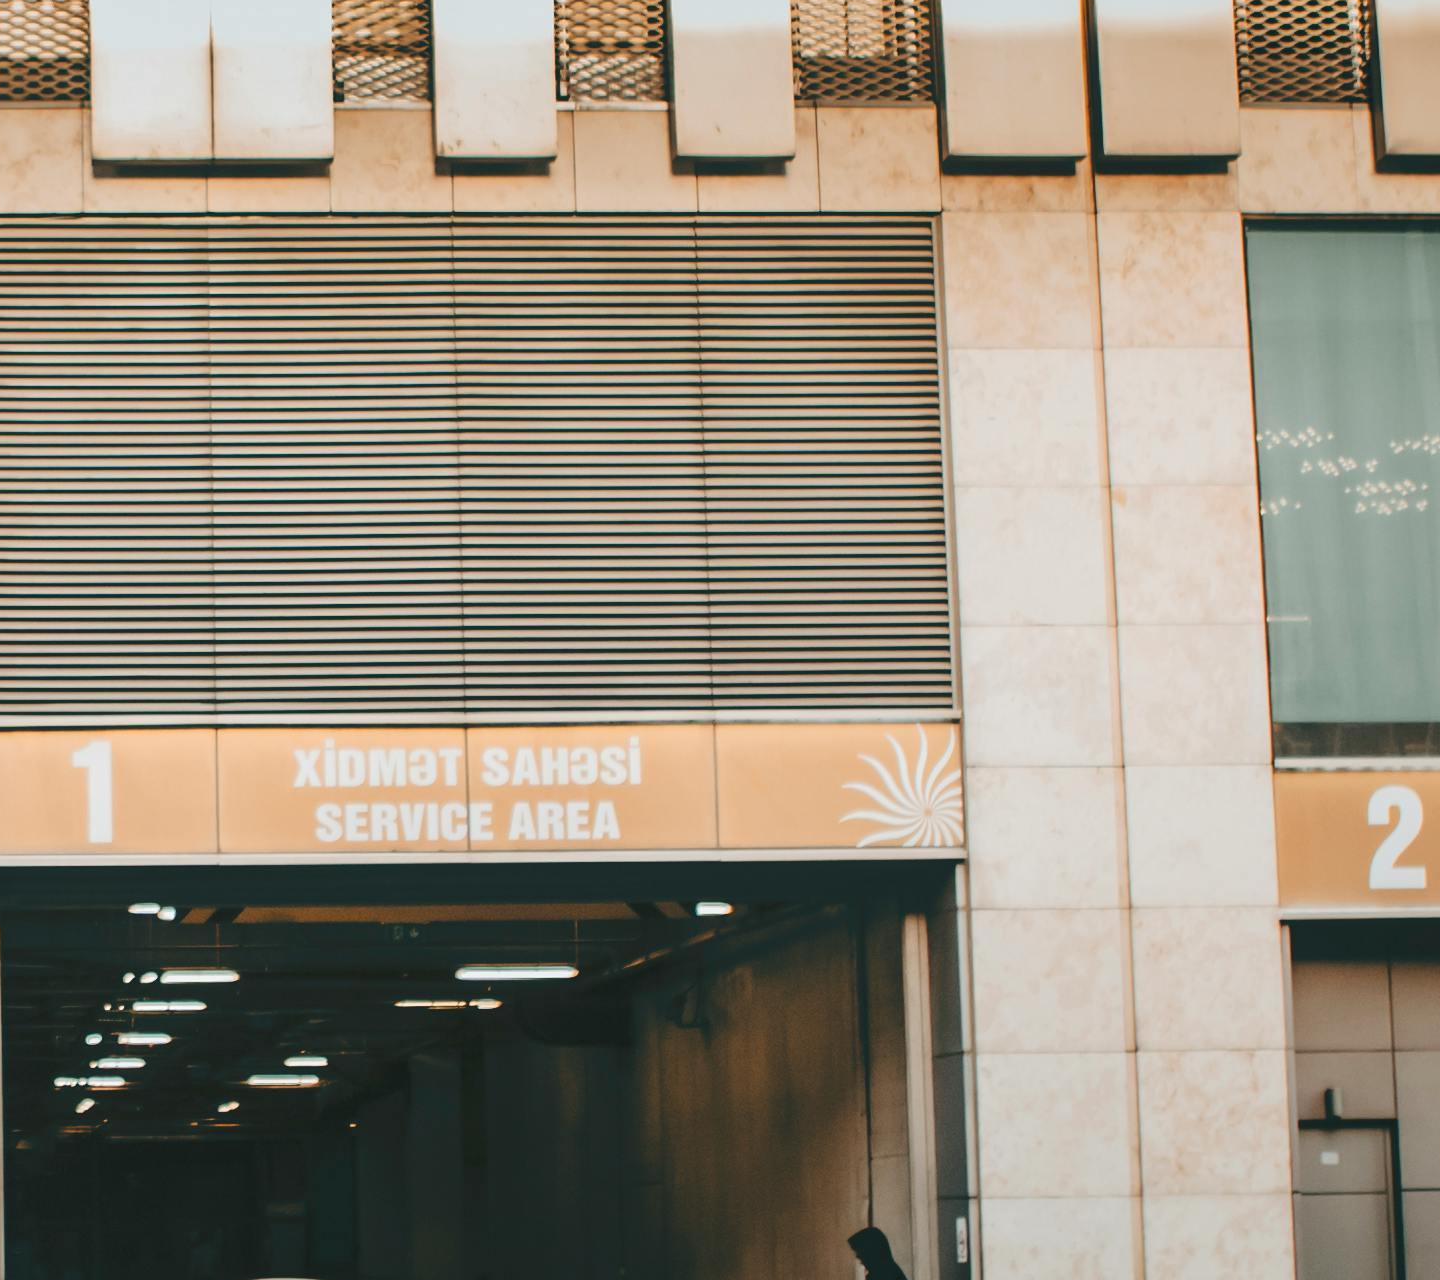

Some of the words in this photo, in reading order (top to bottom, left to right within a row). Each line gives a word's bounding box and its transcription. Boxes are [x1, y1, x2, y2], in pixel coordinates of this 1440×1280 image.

[71, 740, 114, 843] 1
[293, 738, 462, 788] XİDMƏT
[481, 736, 642, 786] SAHƏSİ
[315, 802, 494, 842] SERVICE
[508, 801, 622, 840] AREA
[1367, 785, 1426, 889] 2
